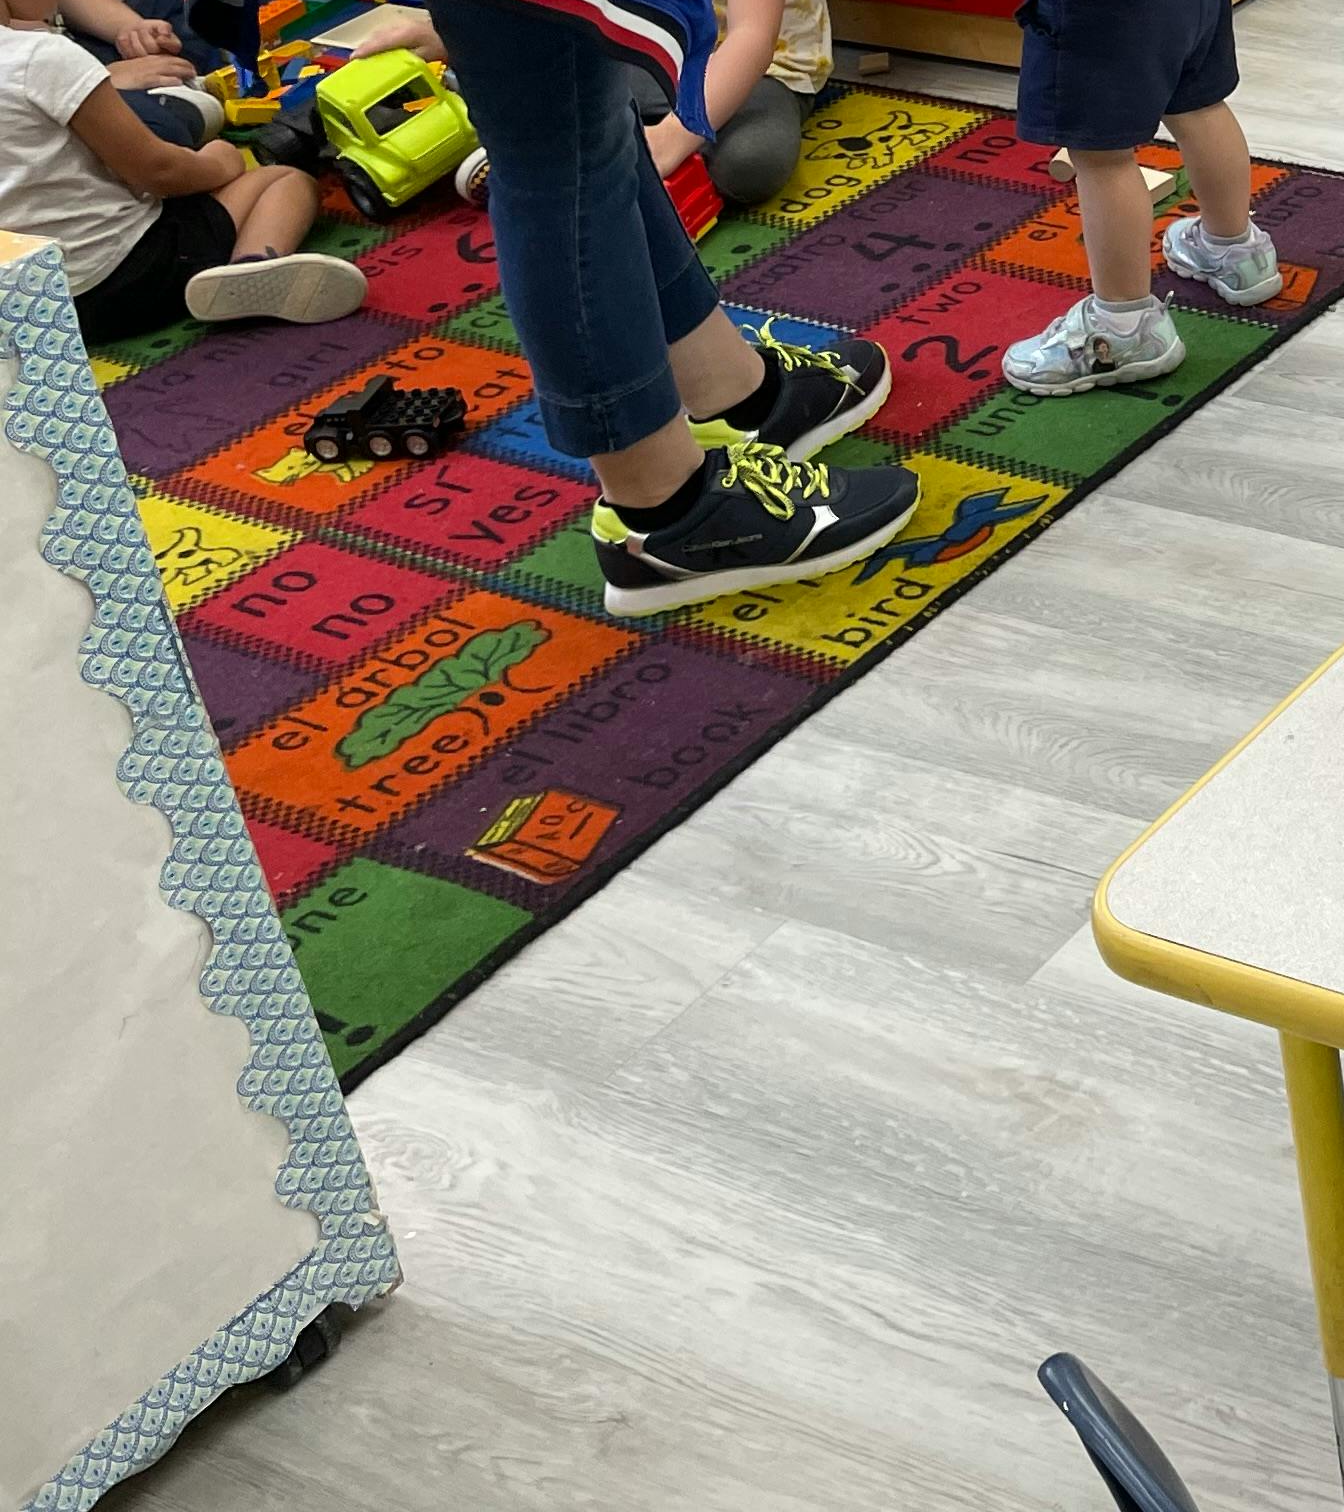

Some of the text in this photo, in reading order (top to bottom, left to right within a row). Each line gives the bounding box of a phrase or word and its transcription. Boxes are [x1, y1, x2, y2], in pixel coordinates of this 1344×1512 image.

[955, 135, 1017, 165] no
[780, 175, 862, 214] dog
[849, 179, 927, 222] four
[851, 232, 937, 262] 4
[1028, 220, 1069, 242] el
[360, 244, 424, 278] eis
[895, 281, 983, 325] two
[267, 341, 349, 387] girl
[385, 345, 446, 372] to
[447, 485, 561, 546] yes
[231, 570, 317, 618] no
[731, 589, 784, 622] el
[821, 576, 935, 649] bird
[311, 592, 396, 640] no
[272, 716, 329, 751] el
[502, 663, 673, 786] el libro
[625, 702, 776, 788] book
[335, 730, 469, 815] tree
